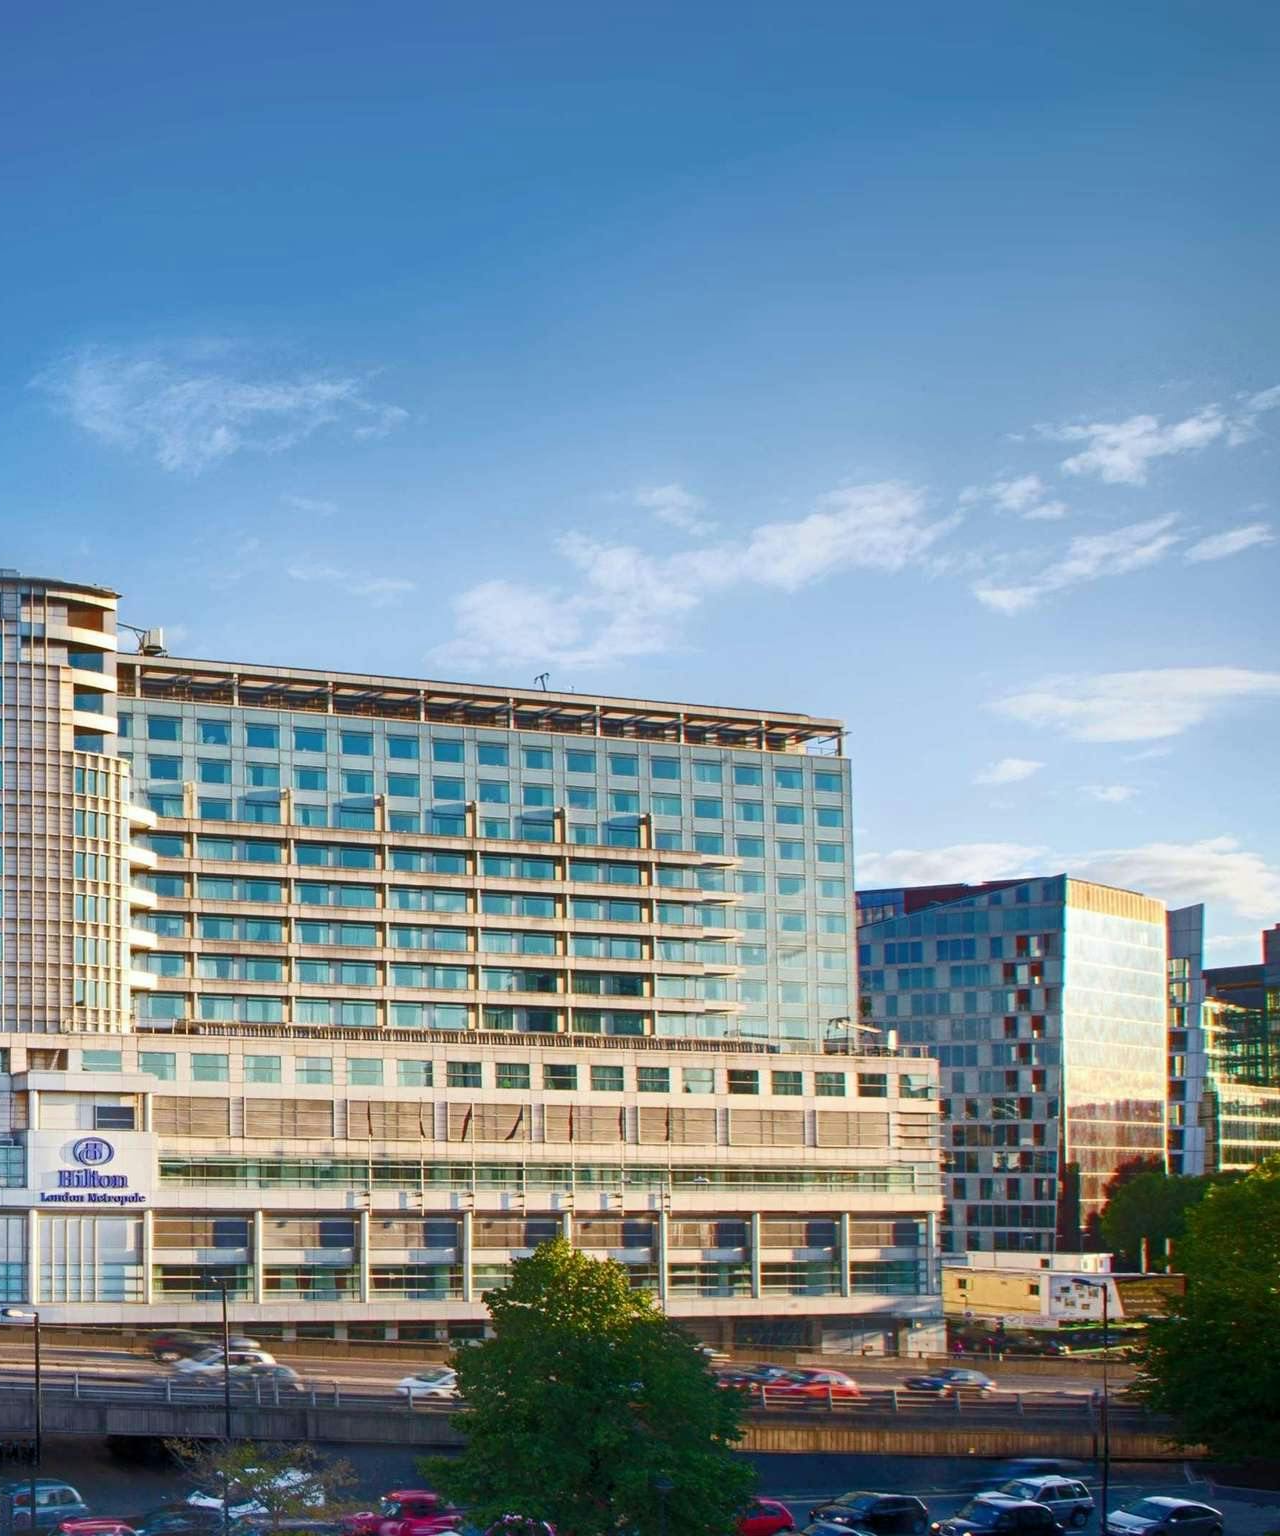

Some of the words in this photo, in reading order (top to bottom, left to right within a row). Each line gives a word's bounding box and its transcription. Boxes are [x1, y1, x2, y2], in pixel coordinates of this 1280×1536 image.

[58, 1168, 128, 1188] Hilton
[40, 1192, 84, 1202] London
[88, 1192, 146, 1205] Metropole
